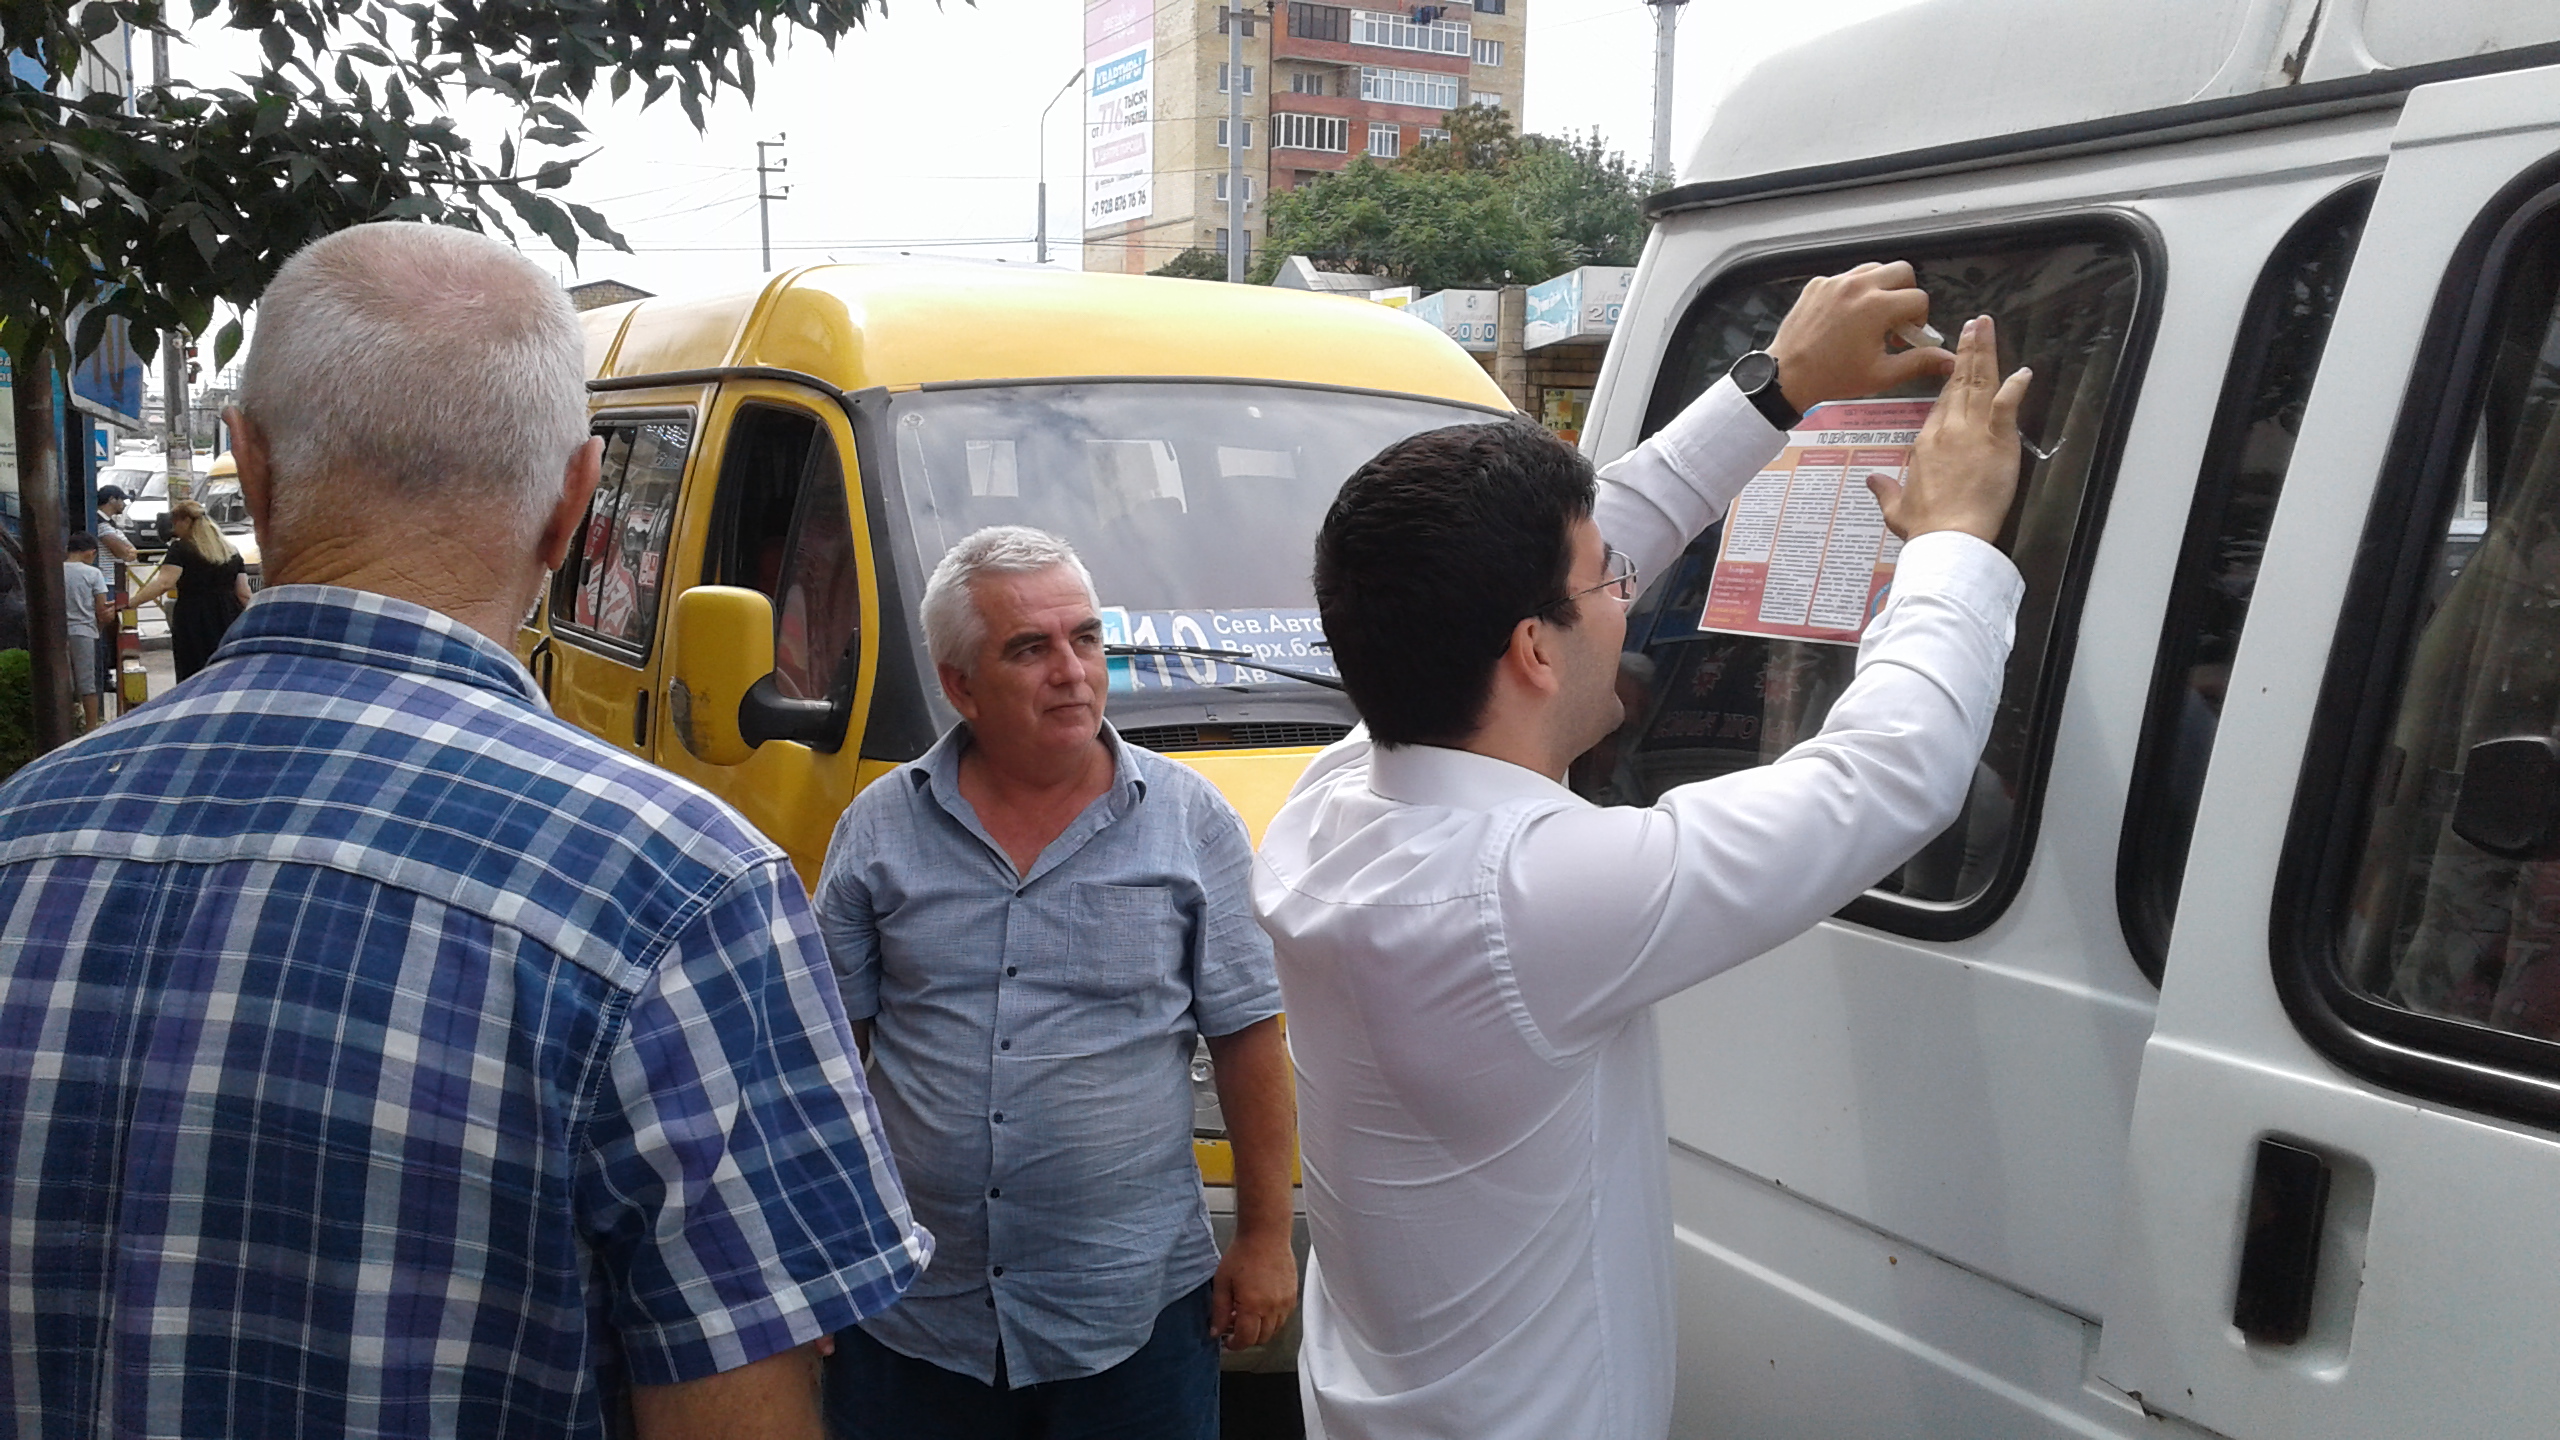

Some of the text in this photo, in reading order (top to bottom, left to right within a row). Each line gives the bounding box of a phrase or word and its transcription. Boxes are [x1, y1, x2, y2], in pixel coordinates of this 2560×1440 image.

[1124, 89, 1148, 109] ТЫСЯЧ
[1124, 106, 1148, 128] РУБЛЕЙ
[1449, 324, 1496, 341] 2000
[1828, 431, 1875, 445] ДЕЙСТВИЯМ
[1875, 431, 1892, 444] ПРИ
